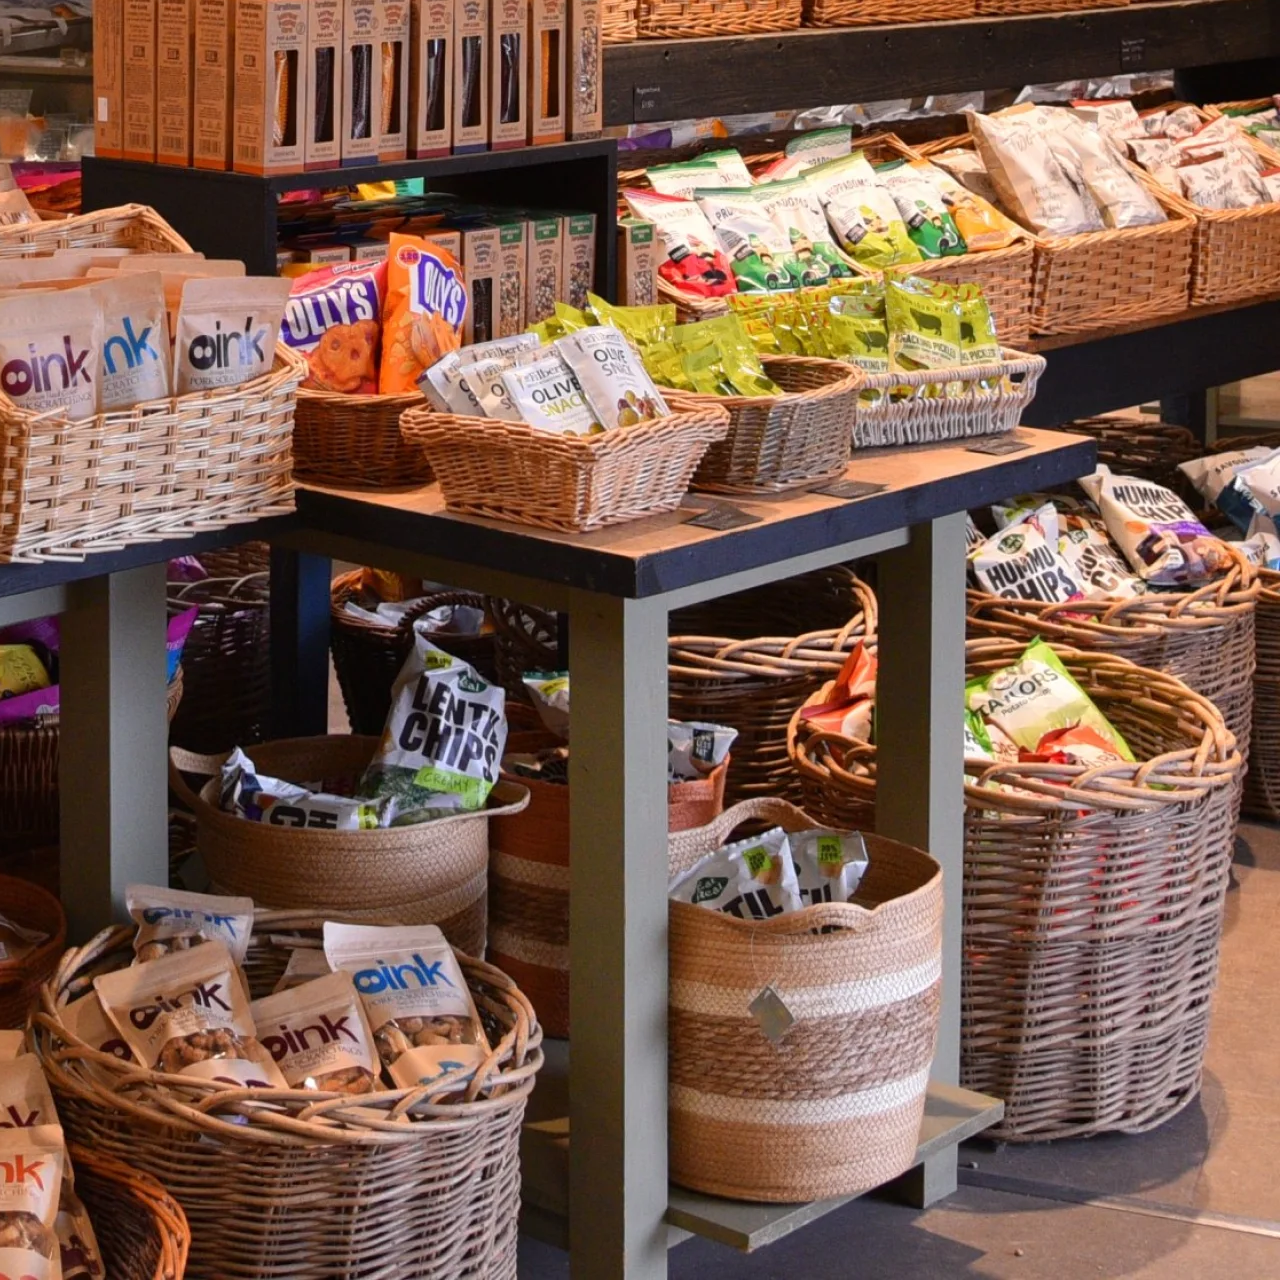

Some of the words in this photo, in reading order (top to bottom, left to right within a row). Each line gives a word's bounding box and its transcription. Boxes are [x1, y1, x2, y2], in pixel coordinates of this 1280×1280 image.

[285, 282, 374, 340] OLLY'S
[424, 261, 462, 326] OLLY'S
[1, 335, 92, 397] oink
[188, 317, 267, 370] oink
[593, 346, 627, 365] OLIVE
[532, 376, 583, 405] OLIVE
[411, 674, 501, 748] LENTIL
[1001, 699, 1029, 718] Potato
[398, 711, 498, 784] CHIPS
[423, 771, 471, 792] CREAMY
[353, 953, 456, 995] oink
[129, 983, 232, 1030] oink
[261, 1014, 359, 1062] oink
